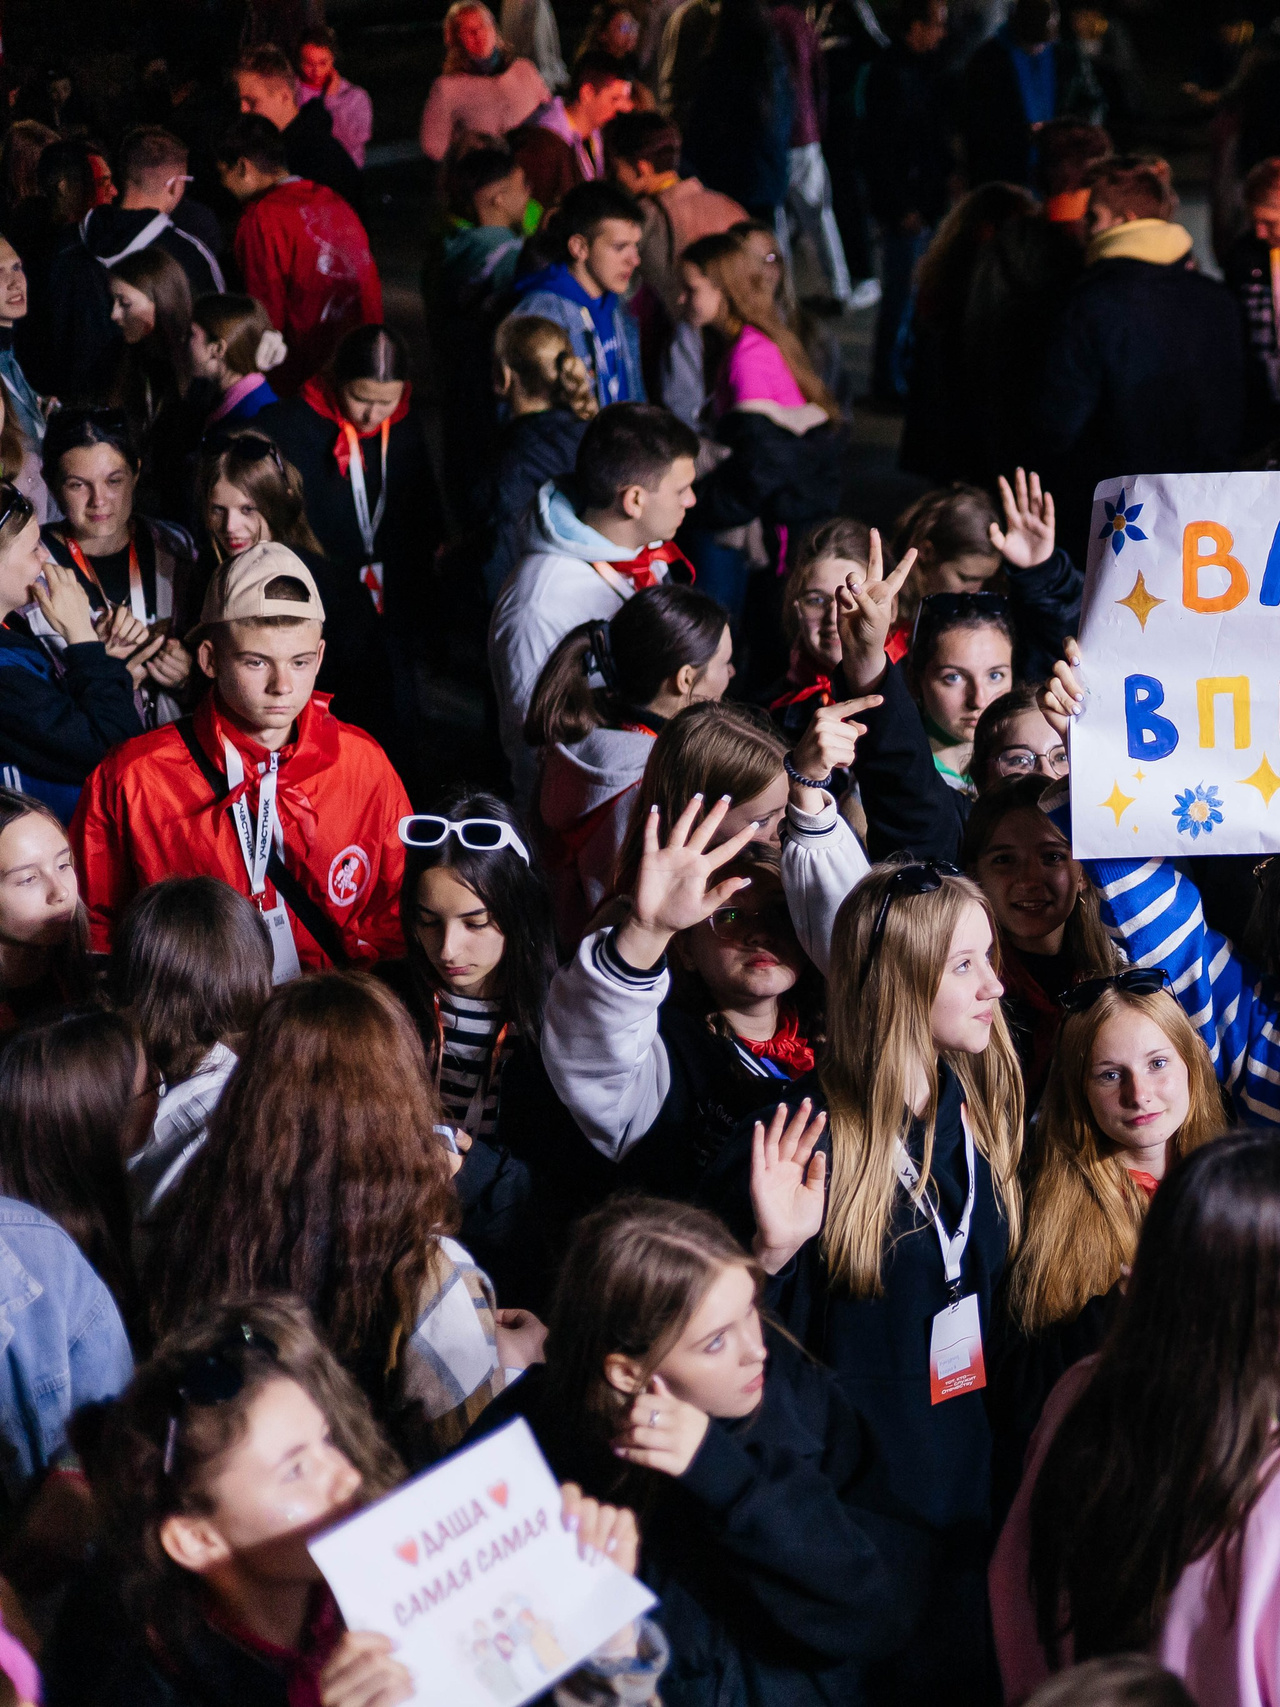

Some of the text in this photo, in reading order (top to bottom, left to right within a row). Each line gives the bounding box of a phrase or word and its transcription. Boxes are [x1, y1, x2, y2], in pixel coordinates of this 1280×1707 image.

[259, 798, 271, 861] участник
[421, 1498, 488, 1559] ДАША
[394, 1507, 548, 1628] САМАЯ САМАЯ
